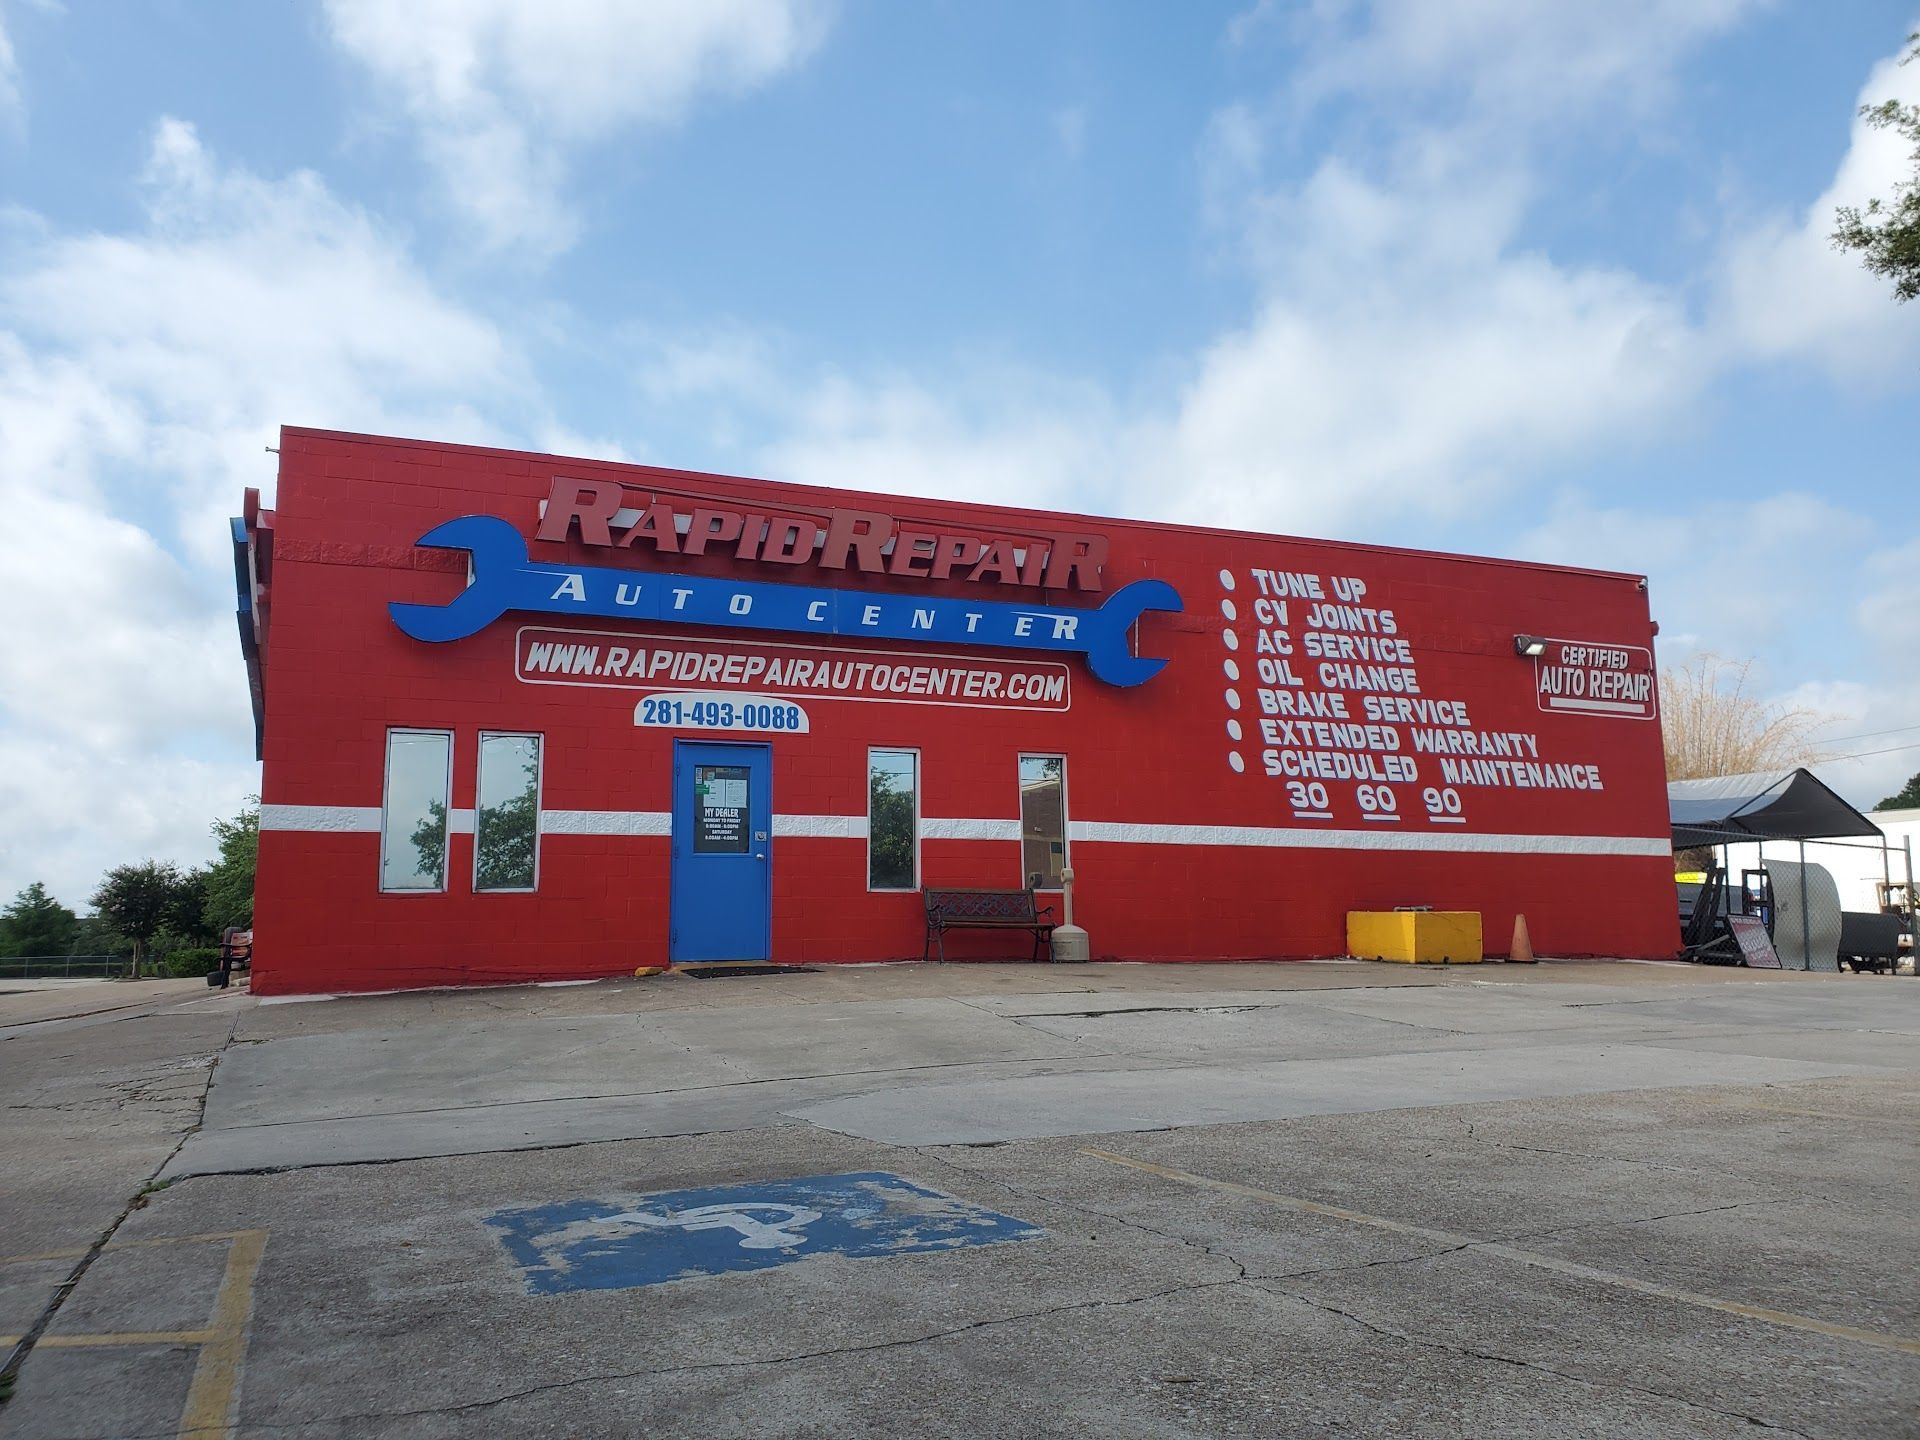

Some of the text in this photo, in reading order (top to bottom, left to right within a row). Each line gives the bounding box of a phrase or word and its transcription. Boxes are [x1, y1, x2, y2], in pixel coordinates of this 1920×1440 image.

[534, 475, 1108, 591] RAPID REPAIR
[1251, 569, 1367, 603] TUNE UP
[550, 573, 1079, 640] AUTO CENTER
[1254, 598, 1398, 634] CV JOINTS
[1257, 629, 1415, 664] AC SERVICE
[1561, 645, 1629, 669] CERTIFIED
[525, 641, 1065, 702] WWW.RAPIDREPAIRAUTOCENTER.COM
[1257, 659, 1420, 693] OIL CHANGE
[1539, 666, 1651, 701] AUTO REPAIR
[643, 699, 799, 730] 281-493-0088
[1257, 688, 1471, 726] BRAKE SERVICE
[1259, 718, 1539, 758] EXTENDED WARRANTY
[1263, 749, 1604, 790] SCHEDULED MAINTENANCE
[704, 807, 739, 818] MY DEALER
[1286, 781, 1463, 814] 30 60 90
